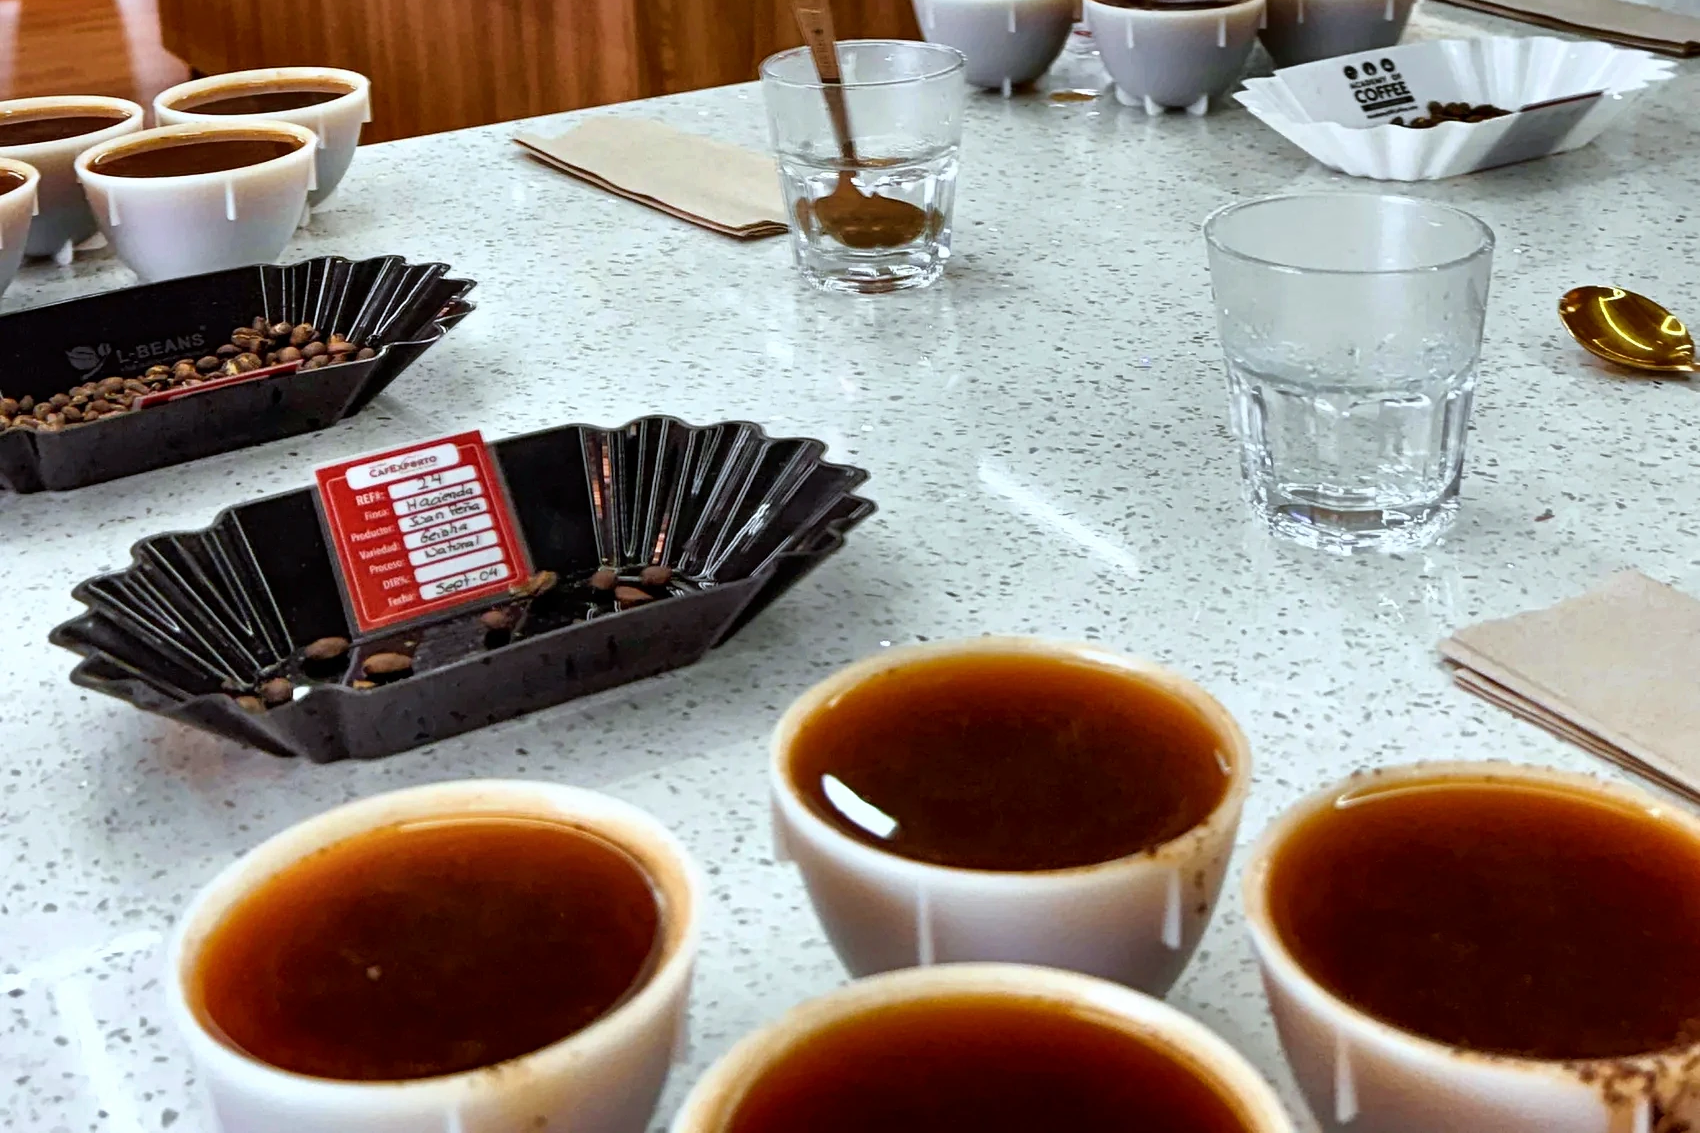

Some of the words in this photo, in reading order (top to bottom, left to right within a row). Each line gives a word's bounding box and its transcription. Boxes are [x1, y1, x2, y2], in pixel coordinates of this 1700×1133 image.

[1354, 81, 1411, 103] COFFEE
[417, 474, 442, 490] 24
[364, 509, 390, 521] Finca:
[406, 485, 474, 511] Hacienda
[351, 525, 395, 542] Productor:
[359, 543, 400, 561] Variedad:
[369, 559, 405, 575] Proceso:
